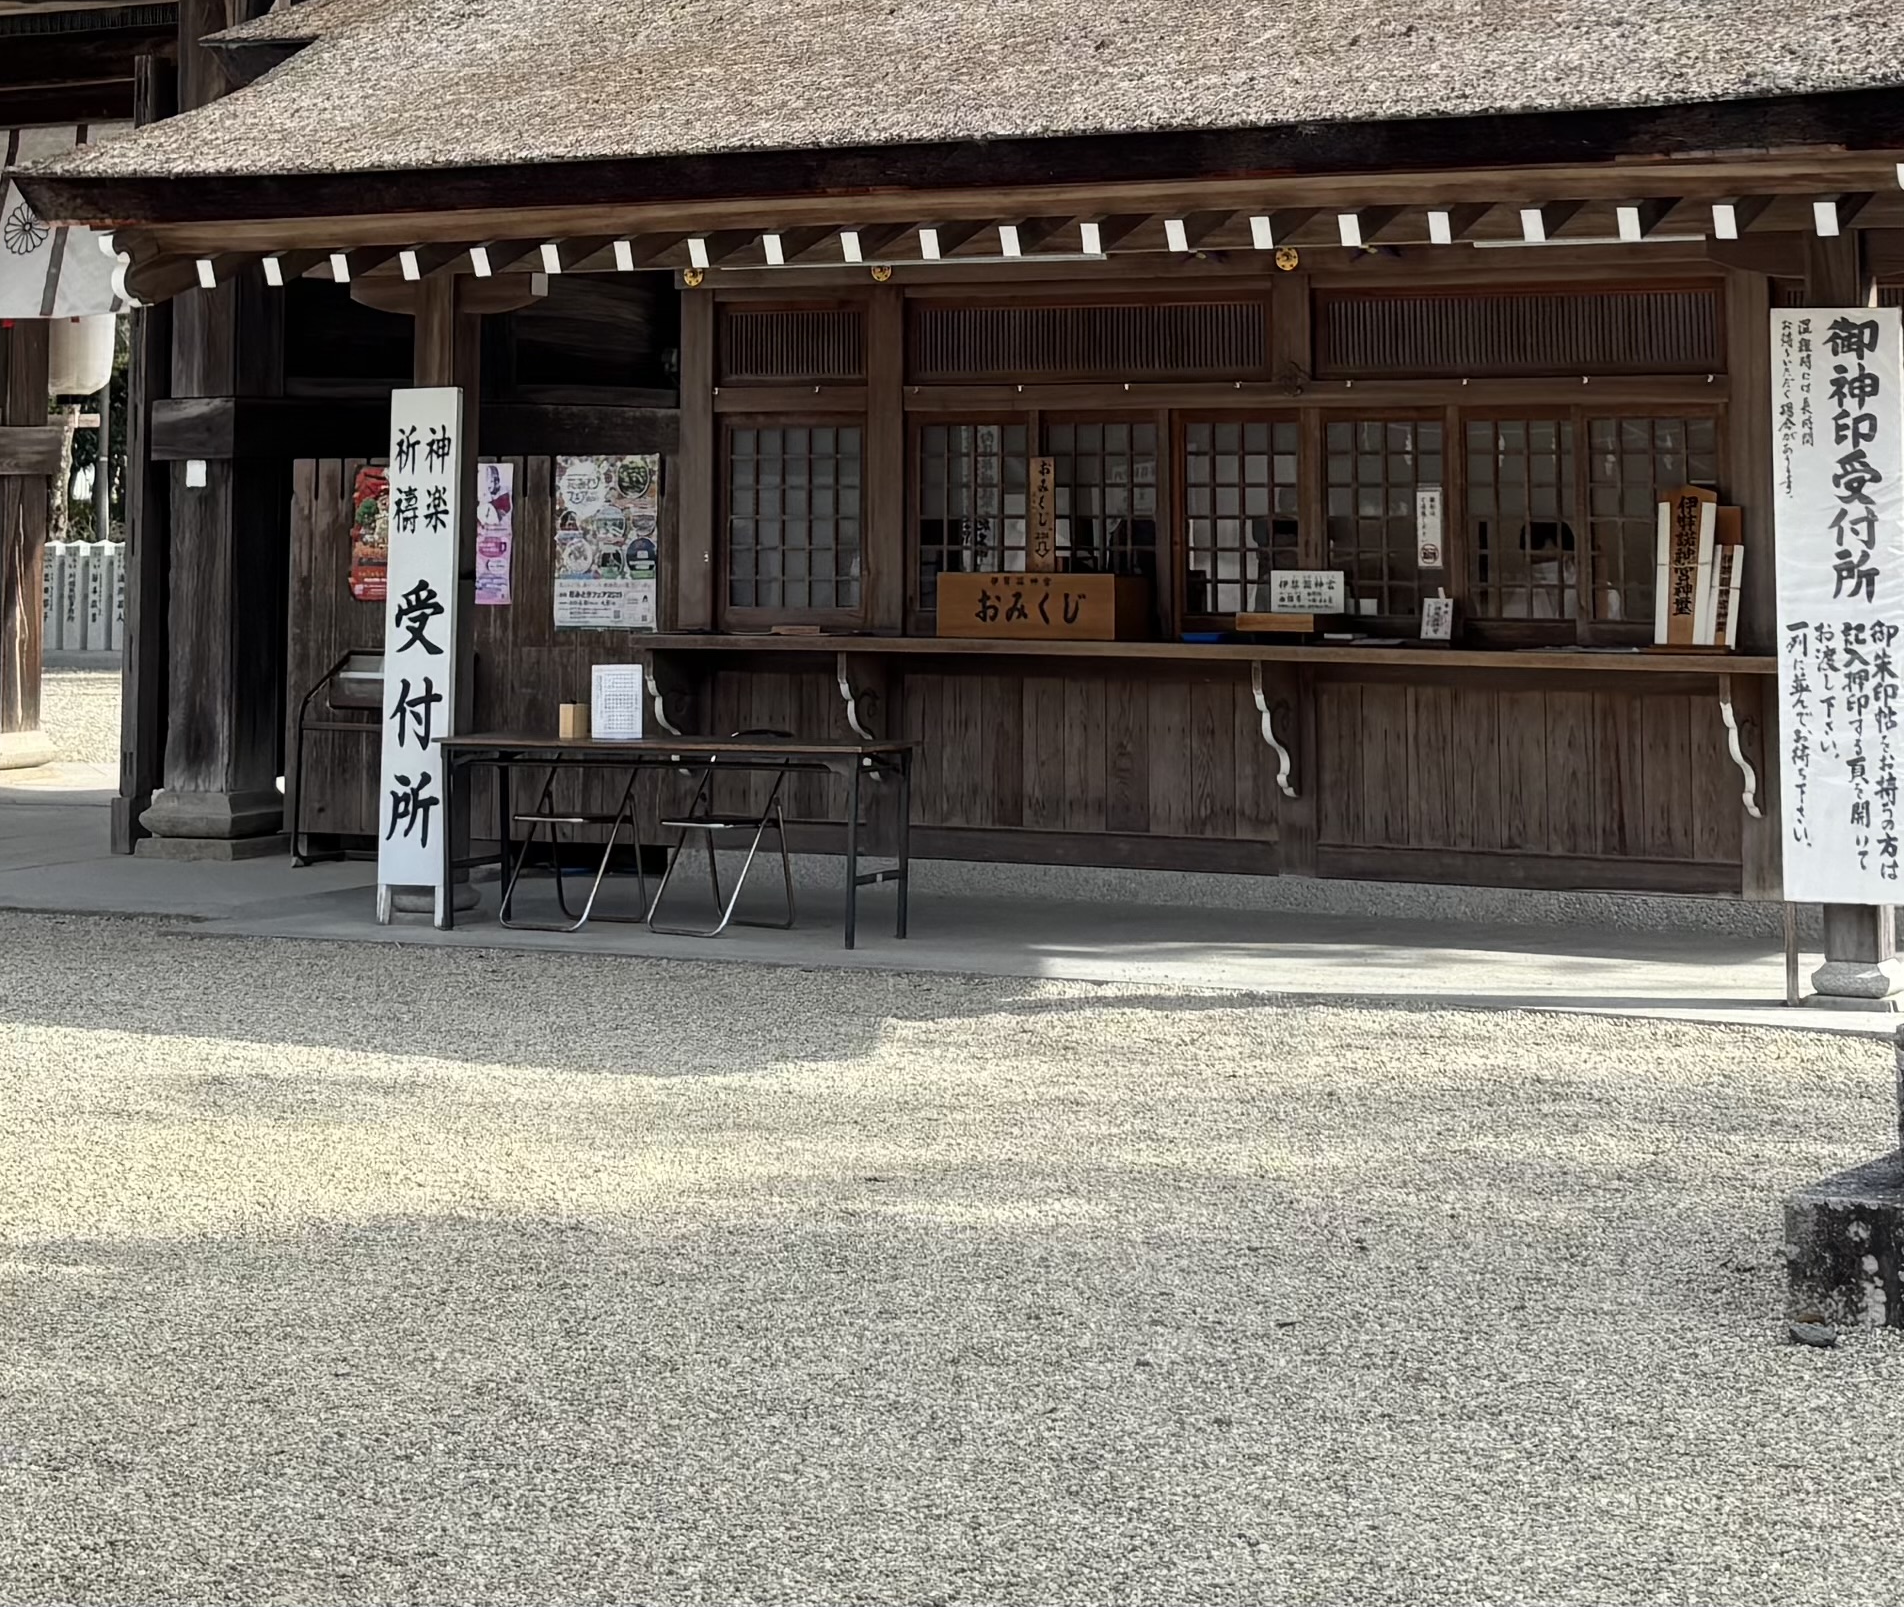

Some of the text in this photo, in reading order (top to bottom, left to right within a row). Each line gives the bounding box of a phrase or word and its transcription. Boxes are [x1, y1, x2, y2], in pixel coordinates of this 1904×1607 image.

[423, 424, 452, 534] 神楽
[1822, 316, 1883, 604] 御神印受付所
[385, 579, 445, 850] 受付所
[975, 589, 1086, 625] おみくじ
[1840, 622, 1871, 870] 記入押印する頁を開いて
